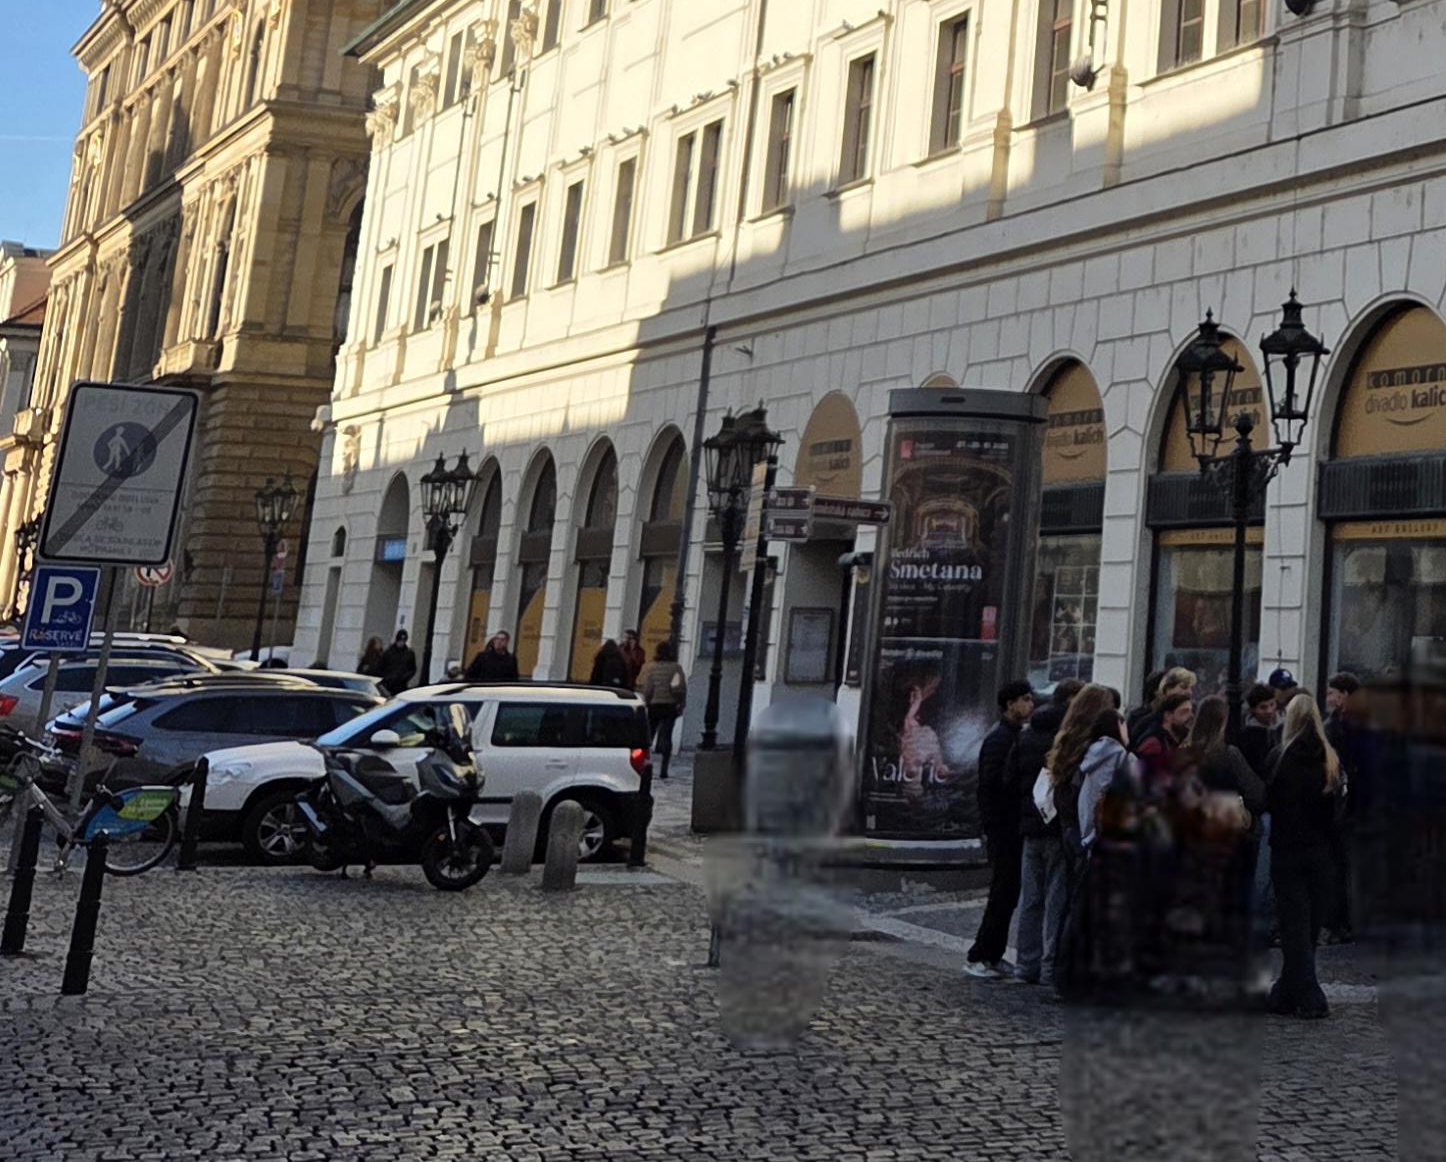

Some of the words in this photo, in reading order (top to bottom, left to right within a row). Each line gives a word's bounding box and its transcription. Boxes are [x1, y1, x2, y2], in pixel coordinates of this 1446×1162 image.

[1366, 391, 1408, 414] divadlo
[889, 560, 983, 580] Smetana
[40, 576, 83, 624] P
